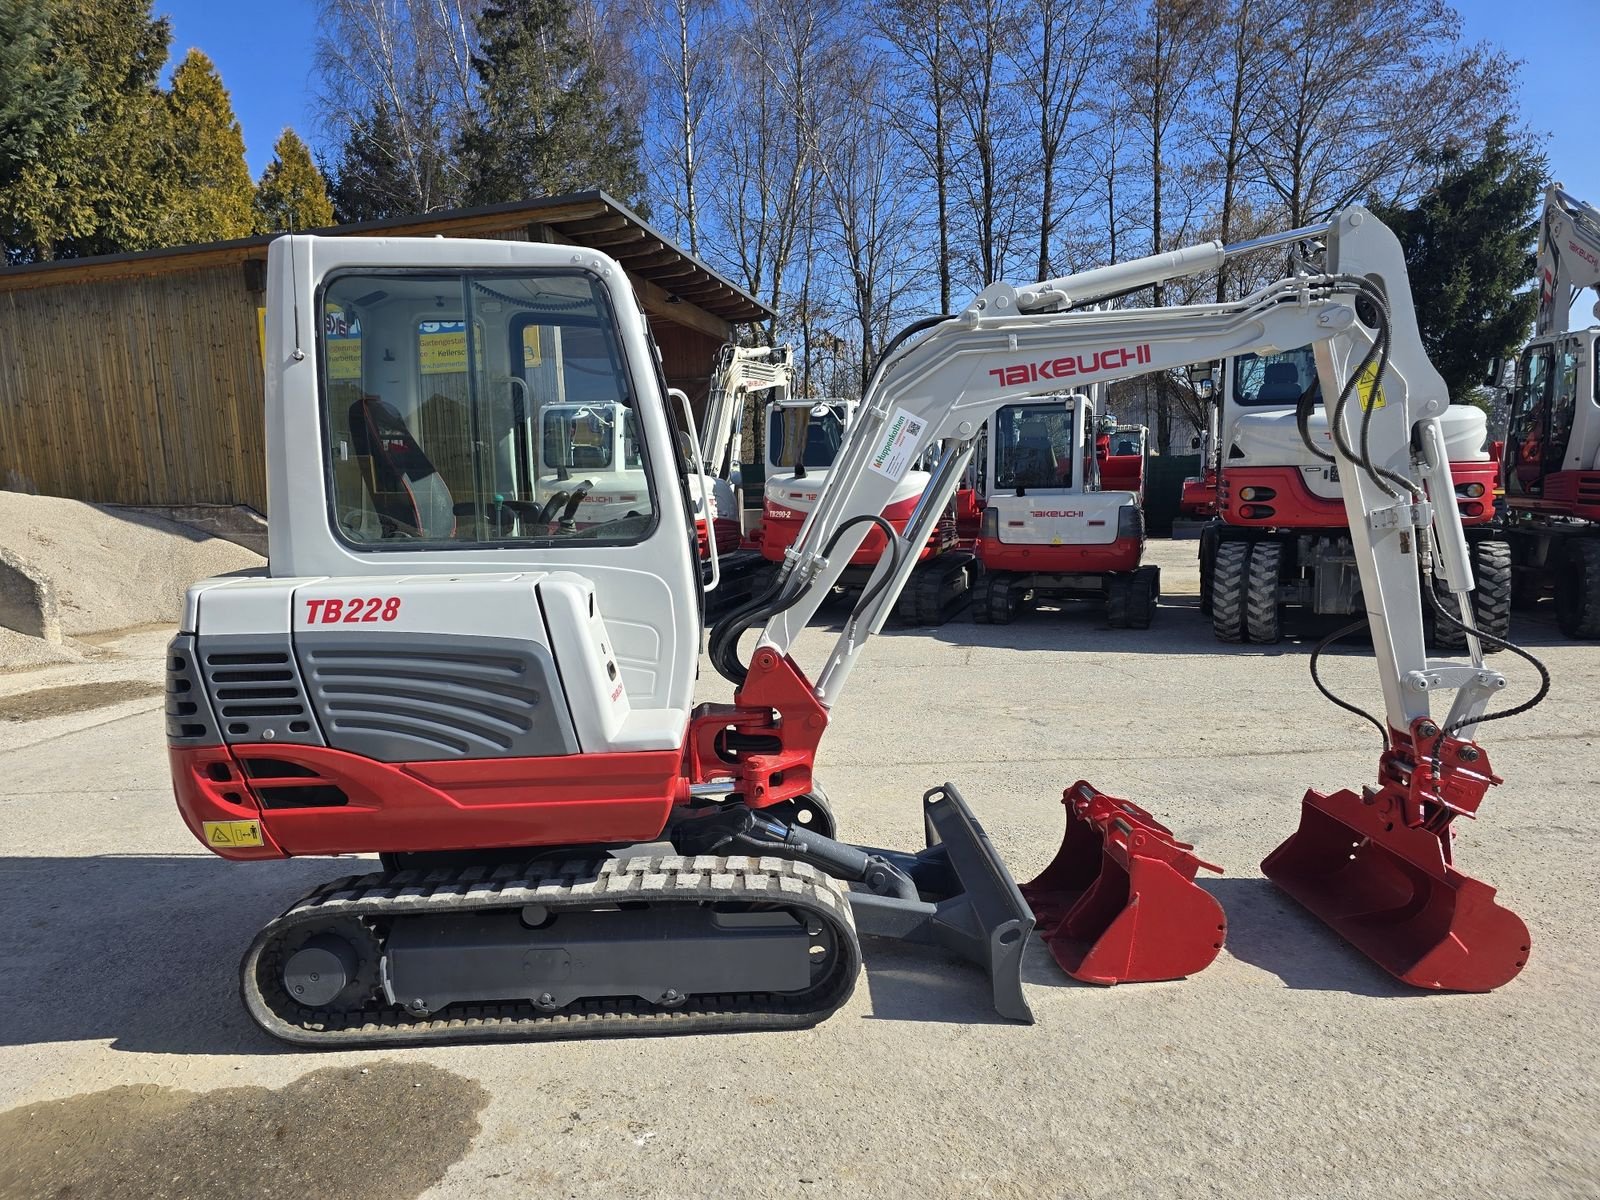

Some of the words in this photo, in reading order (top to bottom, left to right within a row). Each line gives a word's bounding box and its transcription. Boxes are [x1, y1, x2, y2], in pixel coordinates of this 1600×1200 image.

[989, 344, 1151, 387] TAKEUCHI
[876, 415, 906, 464] Huppenkothen
[1030, 510, 1084, 518] TAKEUCHI
[306, 597, 401, 624] TB228
